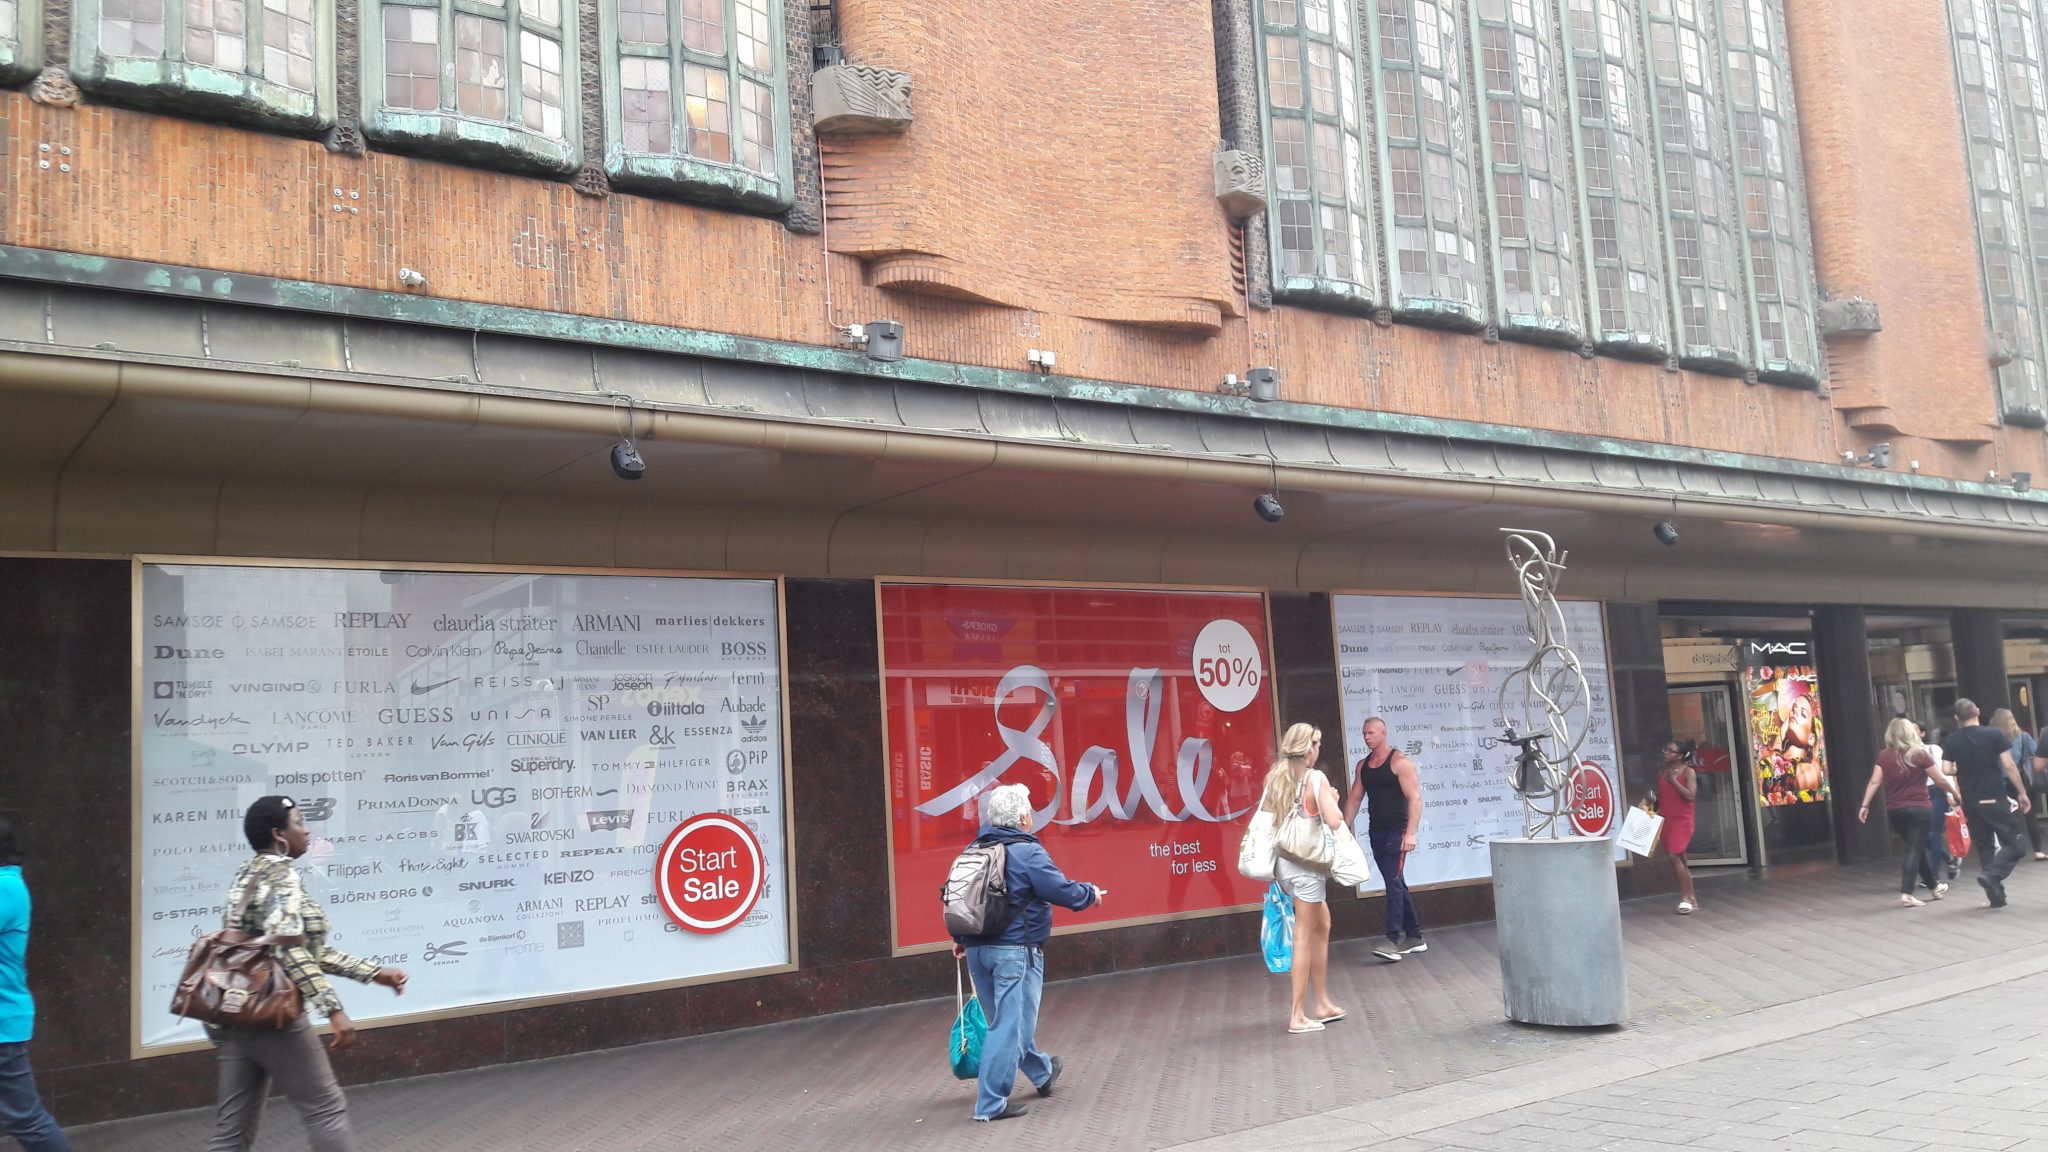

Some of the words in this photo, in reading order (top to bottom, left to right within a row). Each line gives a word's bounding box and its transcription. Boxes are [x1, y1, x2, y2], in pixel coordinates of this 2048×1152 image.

[334, 612, 411, 629] REPLAY
[433, 614, 495, 631] claudia
[500, 614, 557, 631] sträter
[572, 615, 641, 631] ARMANI
[656, 616, 707, 626] marlies
[714, 616, 765, 626] dekkers
[1411, 623, 1443, 633] REPLAY
[153, 645, 225, 659] Dune
[406, 645, 448, 657] Calvin
[451, 645, 481, 656] Klein
[495, 641, 526, 660] Pepe
[525, 642, 563, 660] Jeans
[576, 640, 626, 656] Chantelle
[721, 642, 767, 656] BOSS
[1218, 644, 1231, 654] tot
[1341, 644, 1368, 653] Dune
[1200, 657, 1258, 687] 50%
[231, 683, 305, 692] VINGINO
[334, 681, 395, 694] FURLA
[475, 676, 532, 688] REISS
[1434, 684, 1466, 694] GUESS
[720, 697, 766, 713] Aubade
[378, 707, 453, 724] GUESS
[581, 730, 605, 741] VAN
[610, 729, 637, 740] LIER
[684, 727, 733, 736] ESSENZA
[741, 734, 767, 743] adidas
[327, 738, 354, 748] TED
[367, 736, 414, 747] BAKER
[507, 733, 566, 745] CLINIQUE
[233, 742, 309, 754] OLYMP
[914, 665, 1262, 833] Sale
[592, 761, 640, 771] TOMMY
[659, 758, 710, 768] HILFIGER
[275, 772, 308, 787] pols
[311, 770, 362, 786] potten
[727, 779, 768, 792] BRAX
[471, 788, 516, 808] UGG
[532, 786, 593, 800] BIOTHERM
[1576, 784, 1601, 800] Start
[153, 811, 207, 823] KAREN
[216, 810, 246, 819] MIL
[1579, 804, 1604, 819] Sale
[375, 831, 438, 841] JACOBS
[506, 829, 574, 844] SWAROVSKI
[561, 847, 624, 857] REPEAT
[1150, 842, 1170, 857] the
[1173, 840, 1201, 856] best
[479, 851, 549, 864] SELECTED
[680, 847, 737, 873] Start
[328, 865, 369, 878] Filippa
[372, 862, 382, 873] K
[1171, 858, 1189, 874] for
[1192, 857, 1217, 873] less
[544, 870, 594, 885] KENZO
[459, 879, 514, 891] SNURK
[684, 877, 739, 903] Sale
[330, 891, 376, 904] BJÖRN
[380, 888, 417, 899] BORG
[516, 898, 563, 912] ARMANI
[575, 895, 630, 912] REPLAY
[153, 908, 208, 920] G-STAR
[443, 914, 504, 927] AQUANOVA
